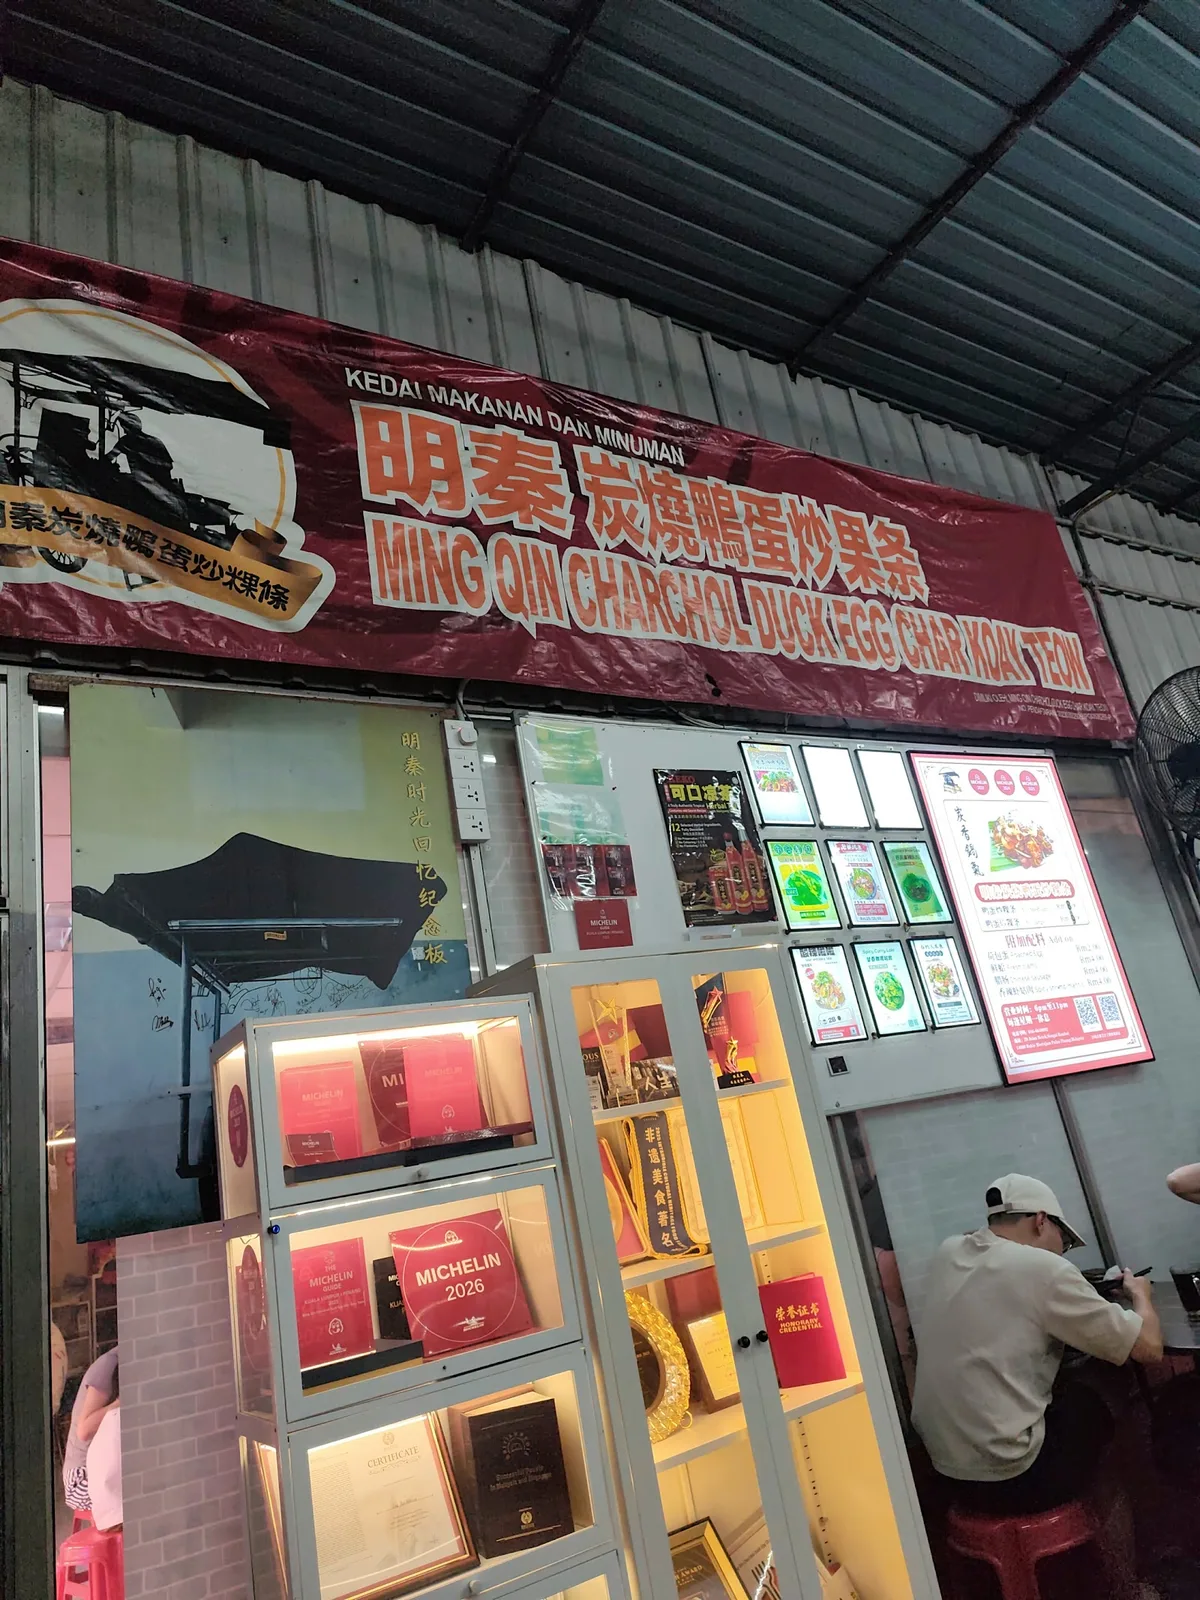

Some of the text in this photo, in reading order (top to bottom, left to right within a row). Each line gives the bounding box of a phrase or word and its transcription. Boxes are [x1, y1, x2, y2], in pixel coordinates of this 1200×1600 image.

[344, 367, 686, 467] KEDAI MAKANAN DAN MINUMAN
[367, 514, 490, 613] MING
[490, 534, 568, 630] QIN
[564, 549, 752, 648] CHARCHOL
[745, 582, 839, 662] DUCK
[829, 596, 897, 667] EGG
[892, 607, 971, 677] CHAR
[961, 617, 1033, 683] KOAY
[671, 823, 681, 832] 12
[309, 1270, 354, 1288] MICHELIN
[415, 1252, 502, 1287] MICHELIN
[322, 1282, 342, 1292] GUIDE
[445, 1278, 485, 1301] 2026
[775, 1302, 821, 1322] 荣誉证书
[778, 1323, 823, 1334] CREDENTIAL
[779, 1317, 819, 1328] HONORARY
[367, 1445, 420, 1469] CERTIFICATE
